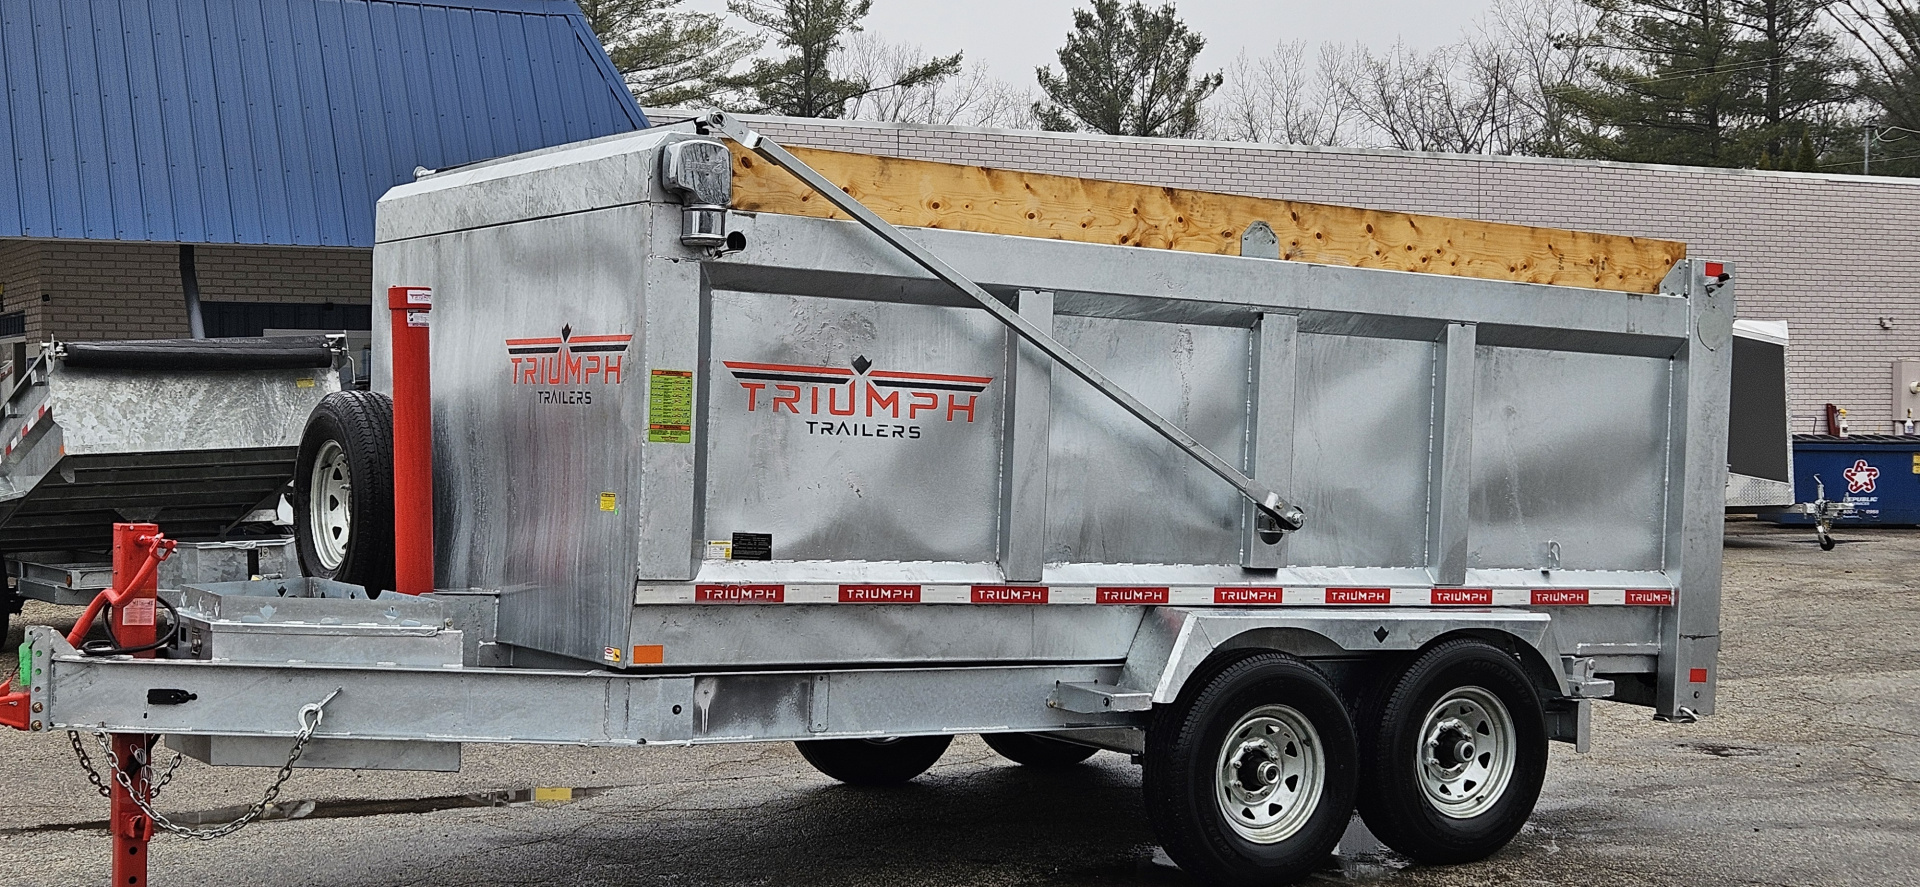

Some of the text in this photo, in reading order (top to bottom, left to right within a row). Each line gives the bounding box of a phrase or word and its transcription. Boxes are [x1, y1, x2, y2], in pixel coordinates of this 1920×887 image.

[511, 348, 622, 385] TRIUMPH
[537, 389, 592, 404] TRAILERS
[739, 380, 978, 423] TRIUMPH
[805, 421, 921, 439] TRAILERS
[704, 588, 776, 600] TRIUMPH
[847, 587, 914, 599] TRIUMPH
[978, 588, 1042, 600] TRIUMPH
[1103, 589, 1162, 600] TRIUMPH
[1220, 589, 1278, 600] TRIUMPH
[1331, 590, 1385, 601] TRIUMPH
[1436, 591, 1487, 601] TRIUMPH
[1535, 592, 1584, 602] TRIUMPH
